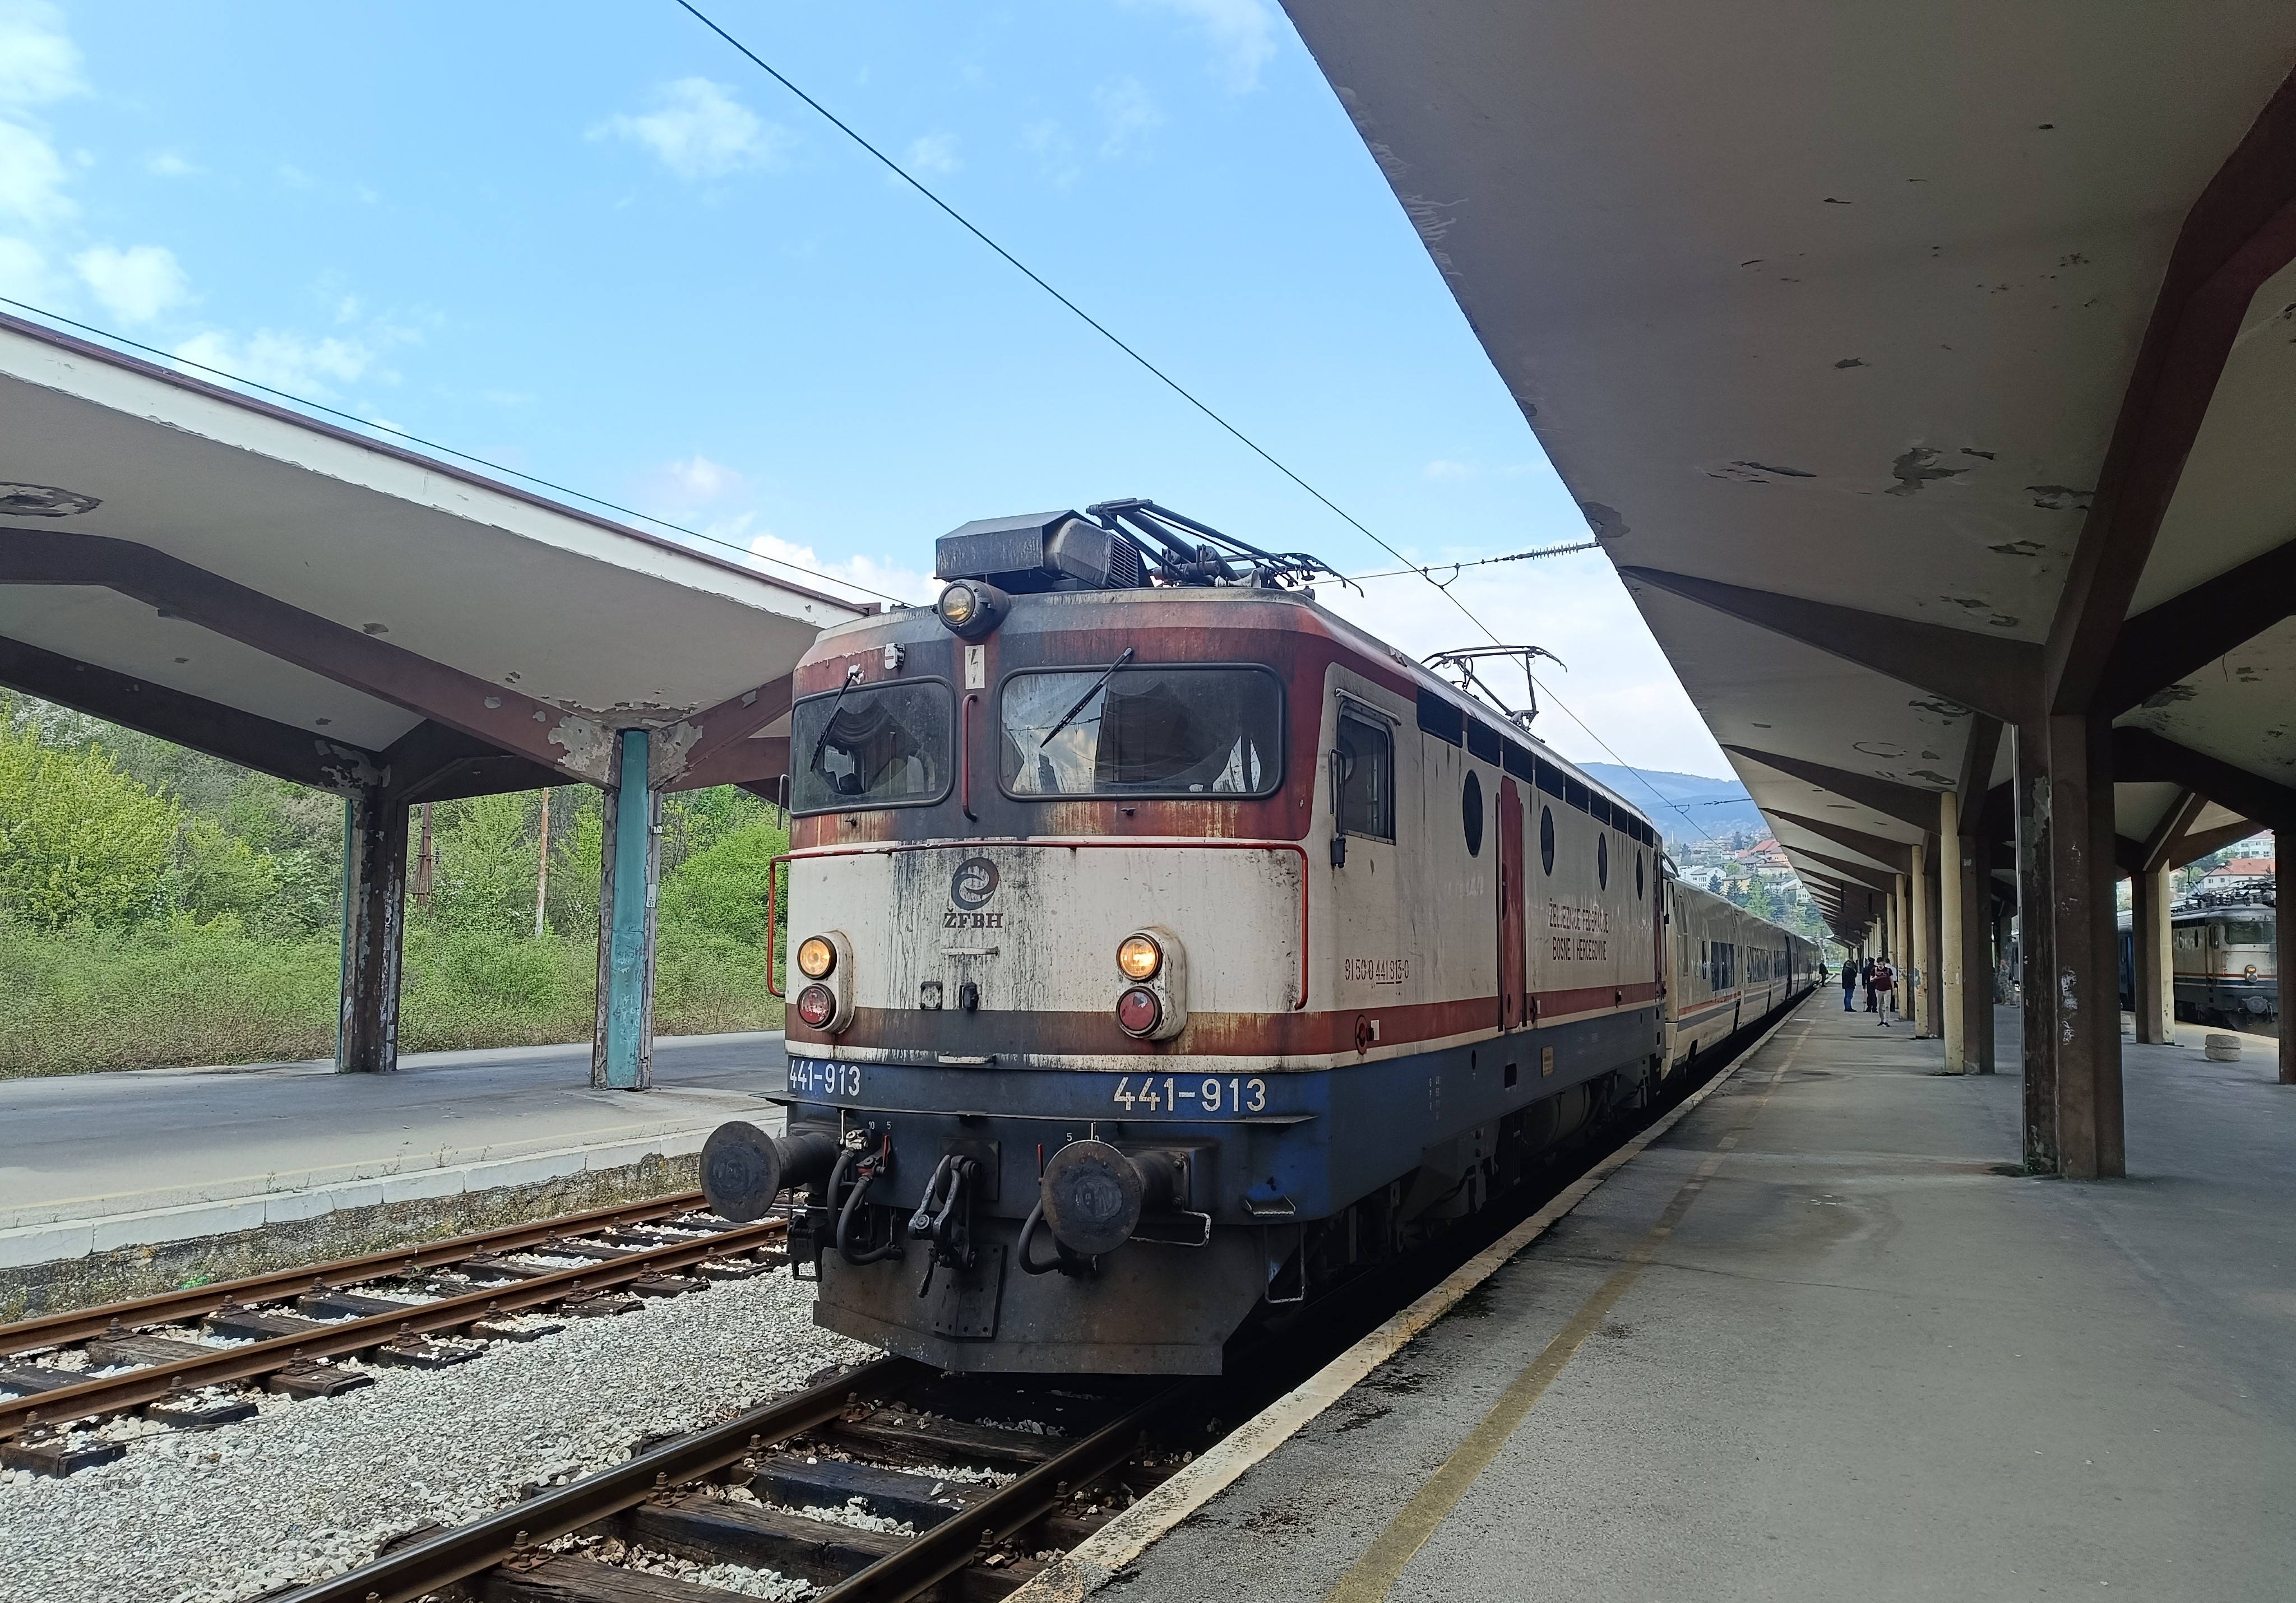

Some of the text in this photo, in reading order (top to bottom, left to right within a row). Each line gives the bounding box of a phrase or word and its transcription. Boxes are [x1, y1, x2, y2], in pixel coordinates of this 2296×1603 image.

[943, 907, 1003, 928] ŽFBH
[1553, 937, 1571, 961] BOSNE
[1576, 938, 1607, 961] HERCEGOVINE
[790, 1059, 860, 1096] 441-913
[1113, 1077, 1266, 1112] 441-913
[868, 1120, 891, 1130] 10 5
[1066, 1132, 1072, 1142] 5
